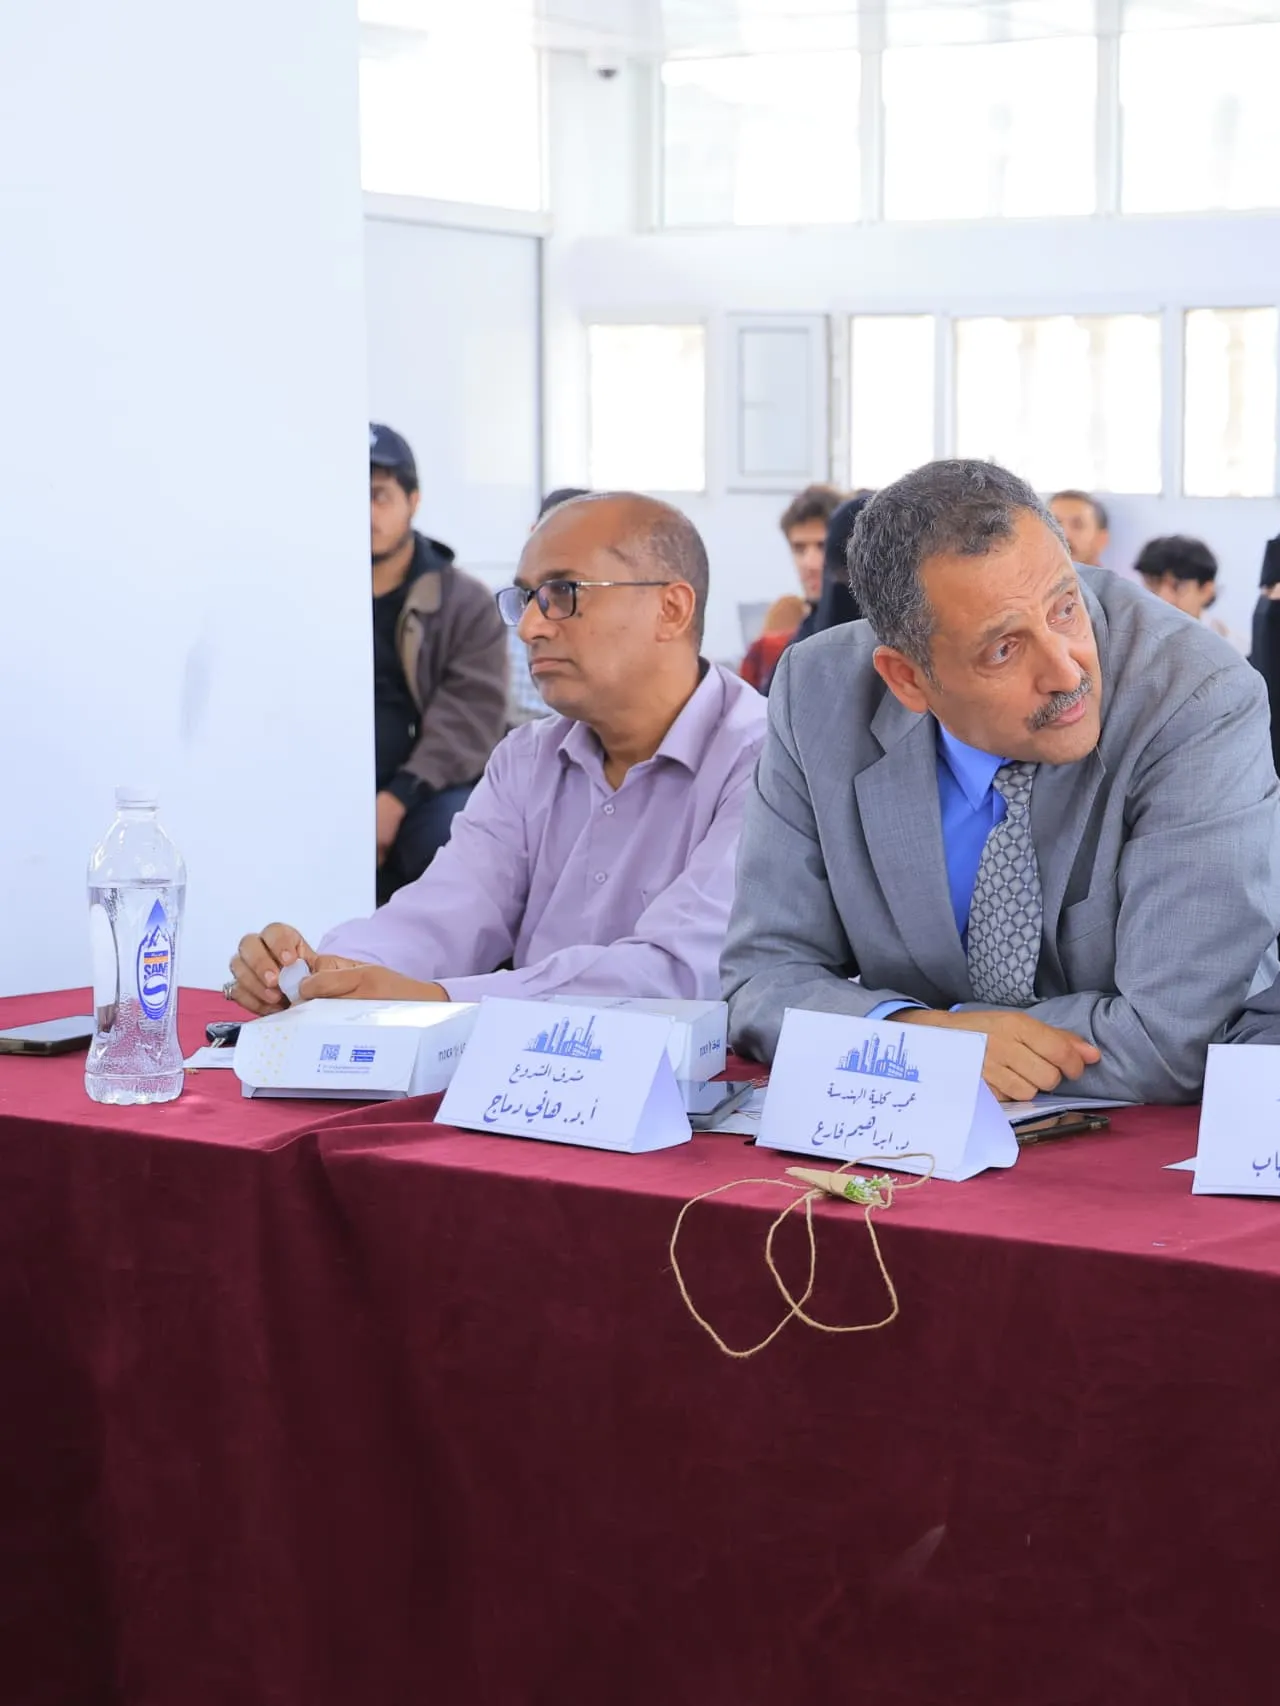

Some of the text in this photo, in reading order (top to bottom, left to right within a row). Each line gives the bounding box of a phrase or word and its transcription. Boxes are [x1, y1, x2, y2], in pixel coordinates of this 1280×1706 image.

[508, 1063, 552, 1085] المشروع
[827, 1082, 867, 1105] الهندسة
[869, 1089, 892, 1110] كلية
[483, 1094, 524, 1124] دماج
[525, 1089, 563, 1124] هاني
